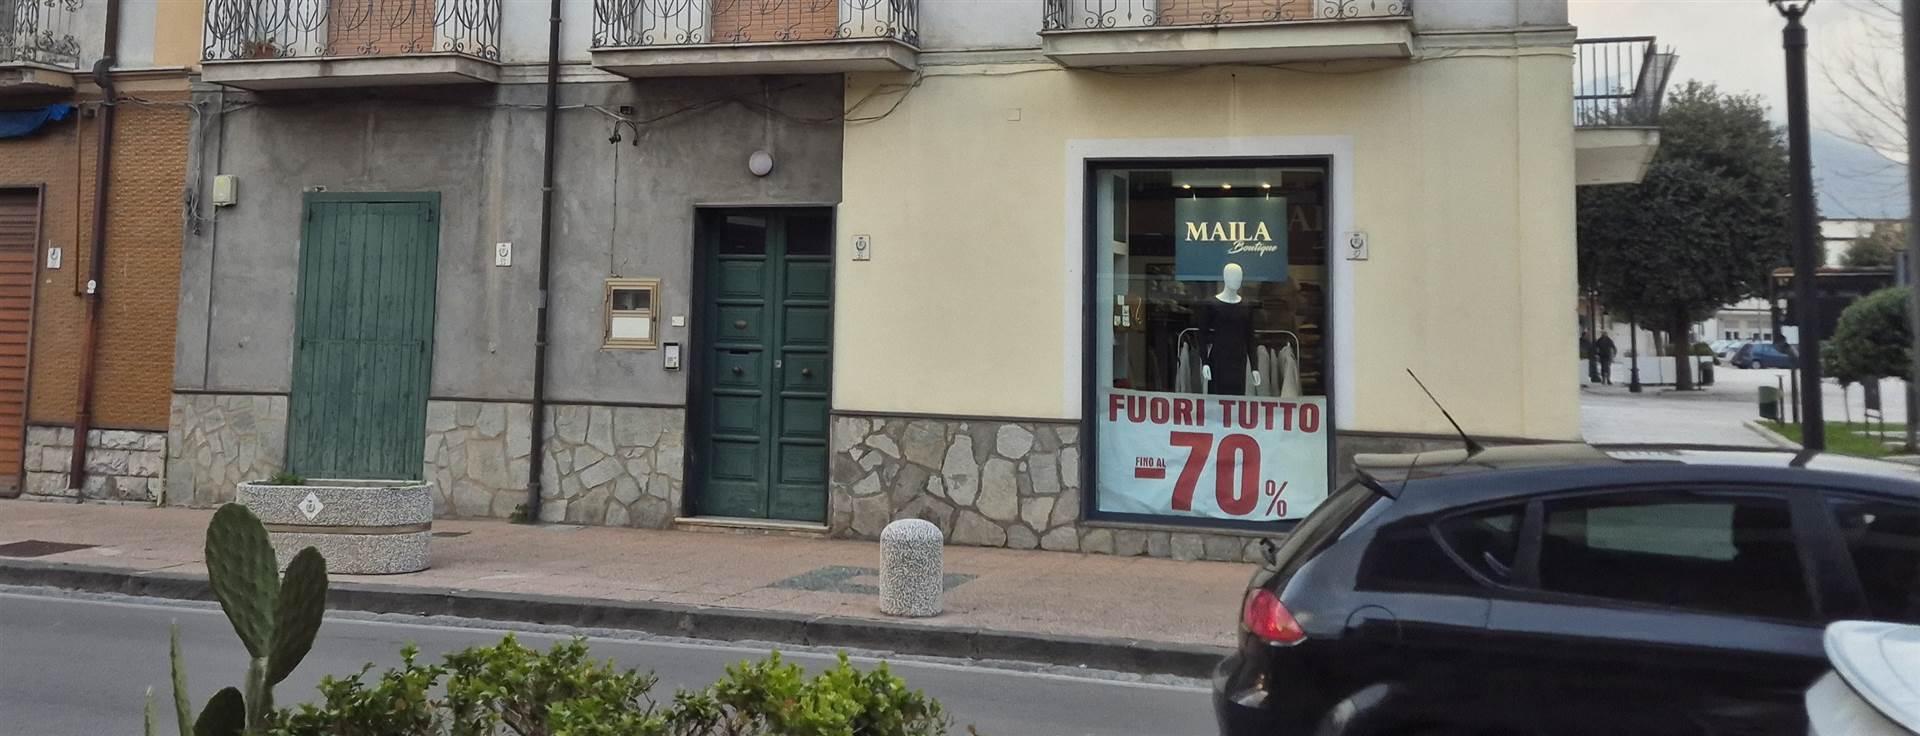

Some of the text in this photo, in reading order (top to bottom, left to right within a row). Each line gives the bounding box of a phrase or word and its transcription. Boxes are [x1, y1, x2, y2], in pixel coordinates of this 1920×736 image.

[1185, 221, 1272, 241] MAILA
[1227, 240, 1278, 256] Boutique
[1109, 394, 1319, 433] FUORI TUTTO
[1135, 456, 1166, 468] FINO AL
